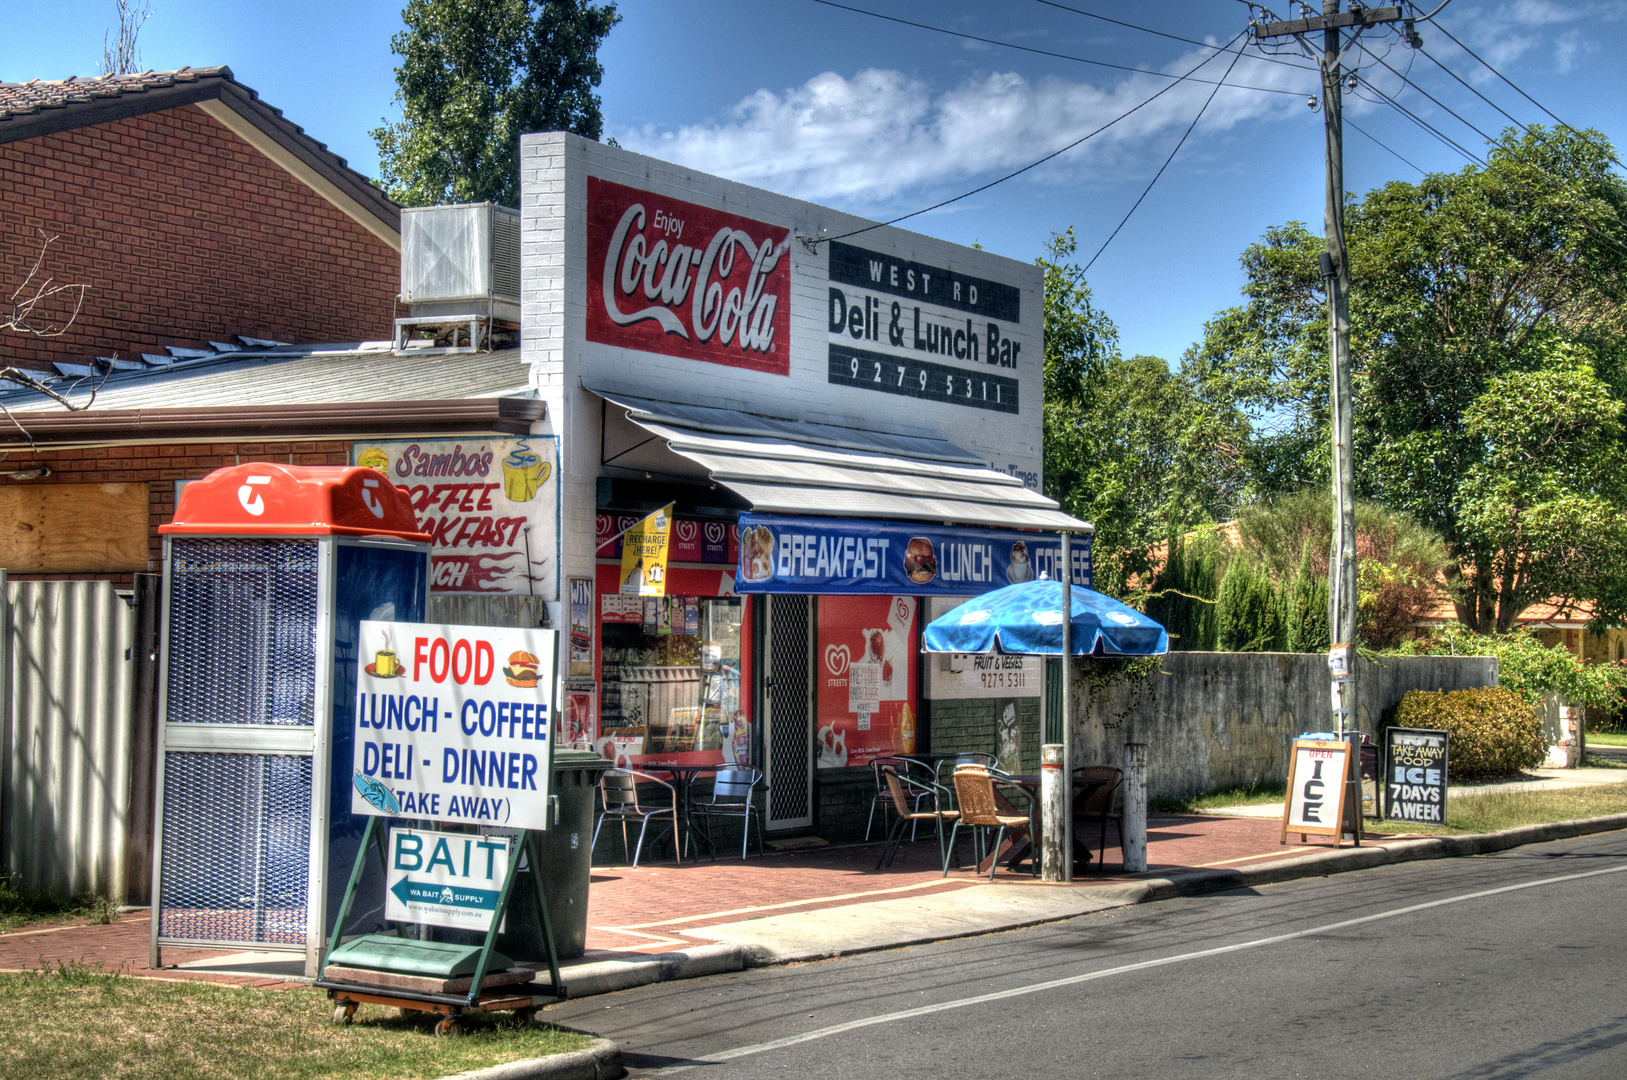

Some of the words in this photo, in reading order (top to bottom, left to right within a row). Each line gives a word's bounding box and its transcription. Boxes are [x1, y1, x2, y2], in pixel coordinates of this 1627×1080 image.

[654, 210, 684, 239] Enjoy
[603, 203, 781, 354] Coca-Cola
[870, 260, 930, 294] WEST
[954, 281, 978, 305] RD
[829, 287, 879, 341] Deli
[889, 301, 904, 347] &
[914, 307, 979, 361] Lunch
[987, 323, 1020, 369] Bar
[851, 357, 927, 391] 9279
[947, 375, 1001, 403] 5311
[396, 444, 493, 478] Sambo's
[1008, 464, 1038, 488] Times
[395, 483, 501, 513] OFFEE
[416, 516, 528, 548] AKFAST
[629, 534, 666, 545] RECHARGE
[635, 546, 658, 555] HERE!
[777, 533, 890, 578] BREAKFAST
[941, 542, 992, 582] LUNCH
[430, 561, 470, 588] NCH
[1036, 548, 1090, 585] COFEE
[413, 636, 495, 686] FOOD
[974, 656, 994, 670] FRUIT
[995, 657, 1000, 670] &
[1002, 656, 1023, 670] VEGIES
[827, 678, 848, 687] STREETS
[981, 672, 1004, 688] 9279
[1007, 672, 1025, 688] 5311
[359, 693, 439, 733] LUNCH
[461, 698, 547, 741] COFFEE
[363, 741, 414, 781] DELI
[443, 747, 538, 791] DINNER
[1309, 750, 1333, 759] OPEN
[1394, 757, 1434, 767] FOOD
[1395, 767, 1441, 785] ICE
[1302, 760, 1325, 823] ICE
[447, 795, 511, 824] AWAY)
[394, 833, 507, 880] BAIT
[408, 904, 482, 918] www.wabaitsupply.com.au
[422, 890, 439, 899] BAIT
[454, 894, 484, 904] SUPPLY
